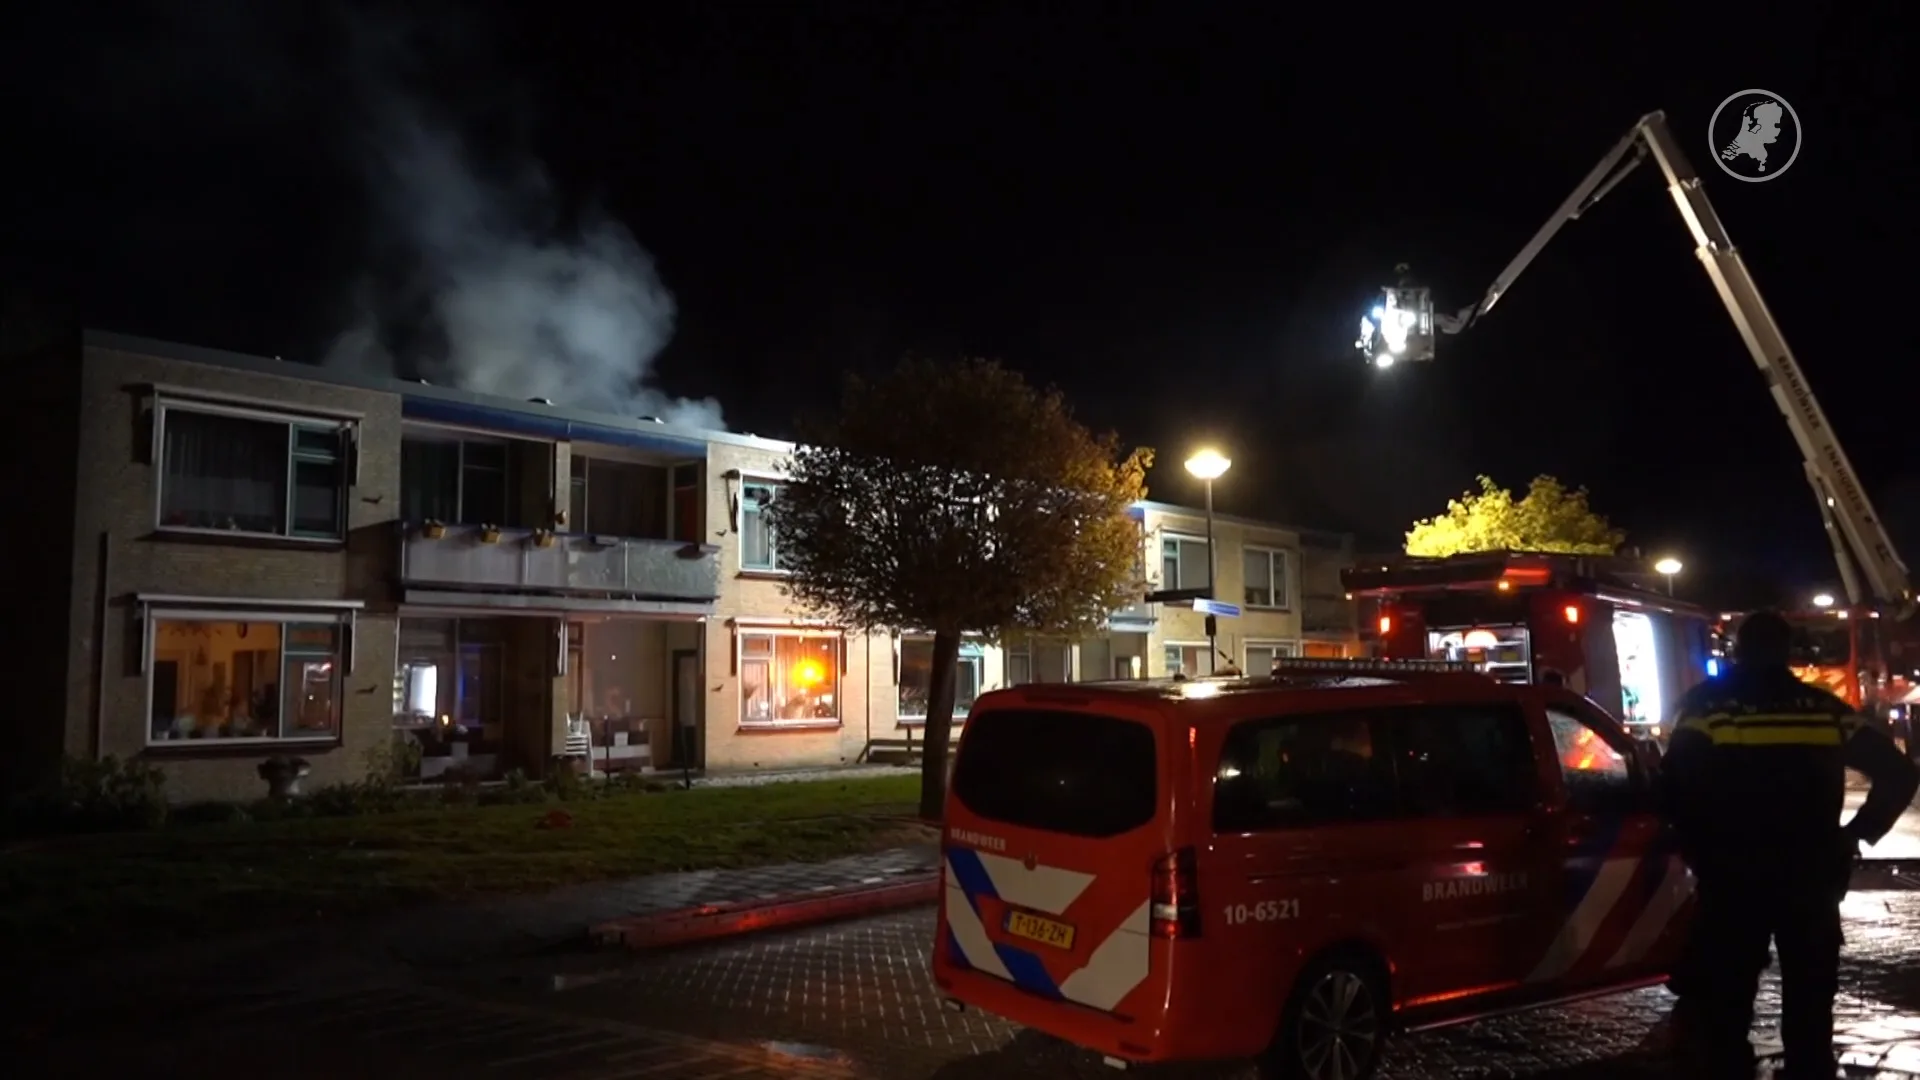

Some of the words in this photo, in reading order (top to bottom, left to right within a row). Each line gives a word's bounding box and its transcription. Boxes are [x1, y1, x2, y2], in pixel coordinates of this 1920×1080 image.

[1778, 356, 1820, 430] BRANDWEER
[950, 828, 1006, 852] BRANDWEER
[1422, 872, 1528, 902] BRANDWEER
[1223, 897, 1300, 925] 10-6521
[1014, 914, 1067, 944] T-136-ZH
